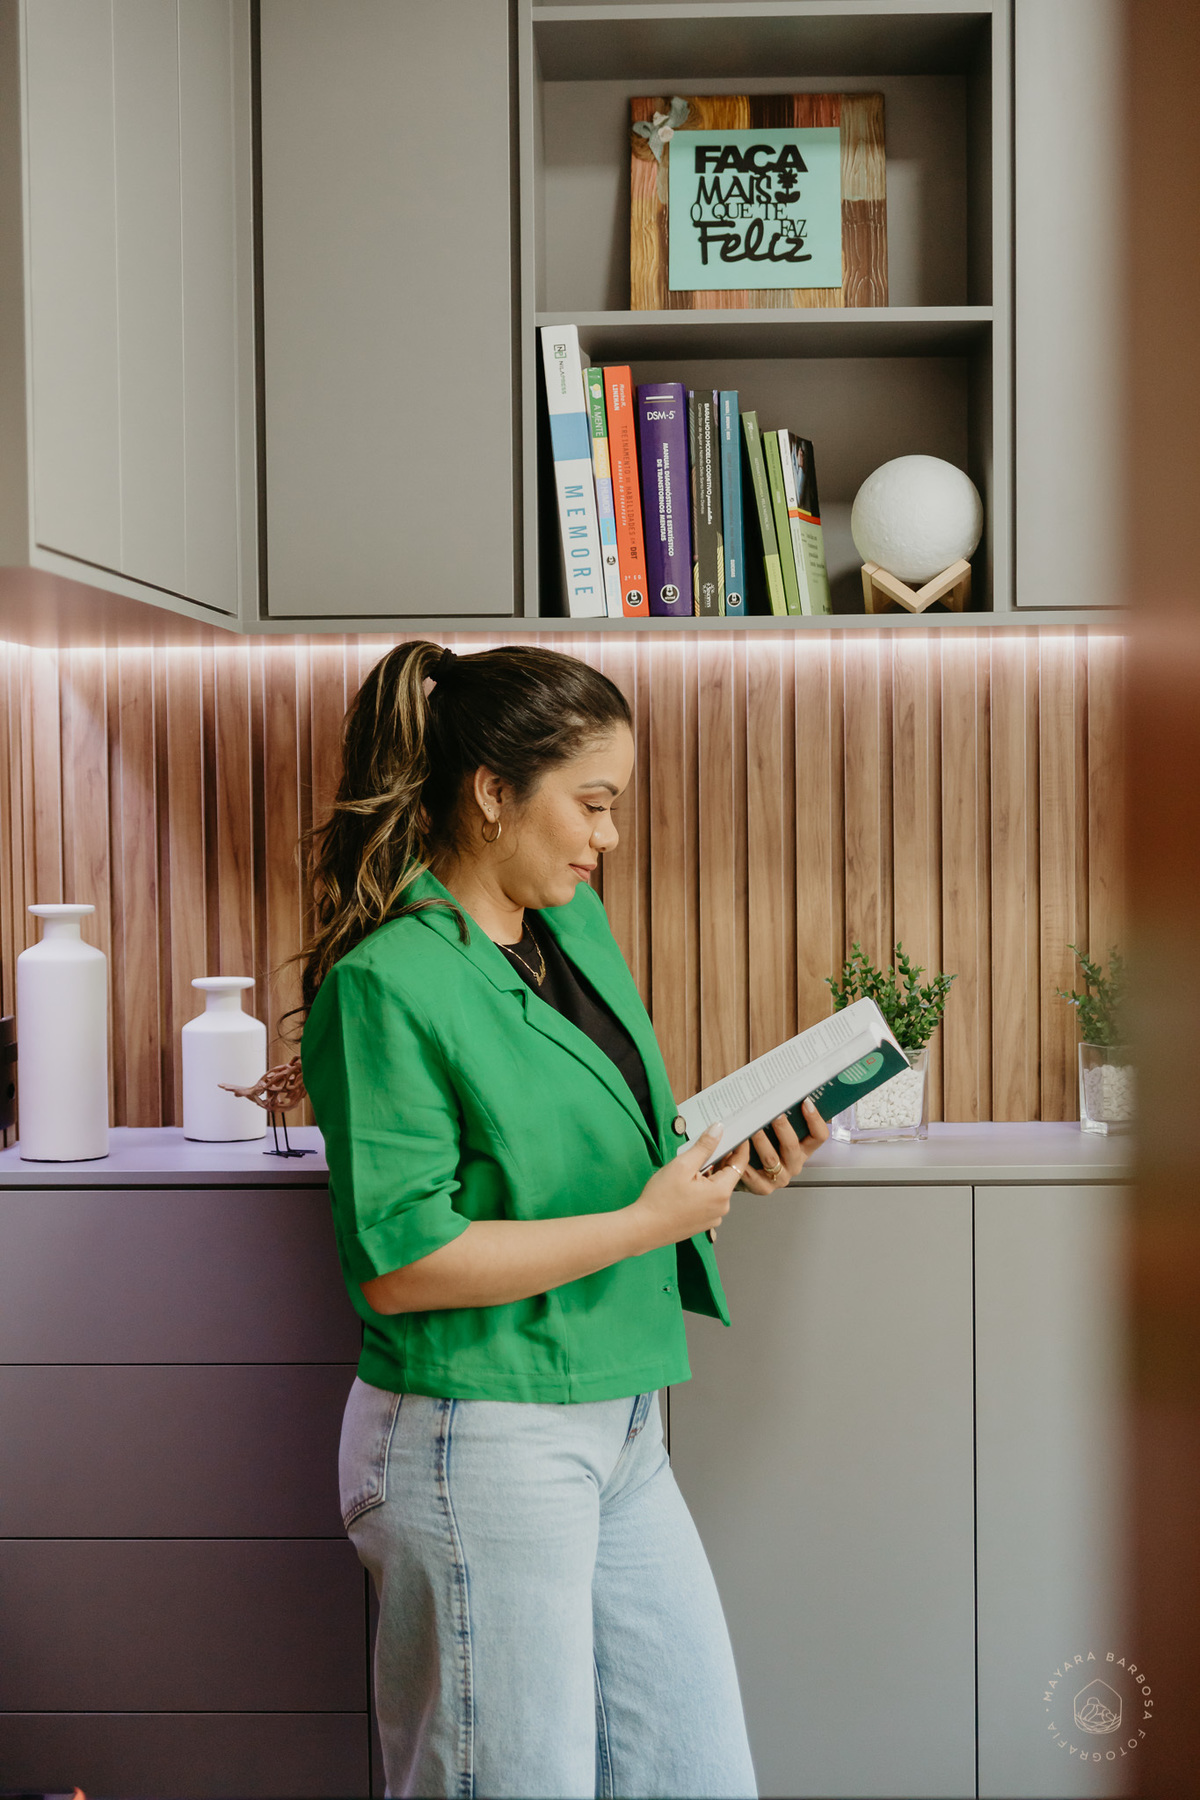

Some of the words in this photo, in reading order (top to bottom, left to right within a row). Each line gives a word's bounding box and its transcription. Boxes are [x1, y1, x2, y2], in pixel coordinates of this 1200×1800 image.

[694, 144, 808, 176] FAÇA
[696, 175, 772, 204] MAIS
[690, 203, 703, 221] O
[712, 203, 753, 221] QUE
[759, 202, 788, 220] TE
[693, 218, 812, 265] Feliz
[780, 219, 808, 237] FAZ
[594, 411, 604, 437] MENTE
[704, 431, 711, 440] DO
[621, 425, 631, 476] TREINAMENTO
[656, 458, 663, 467] DE
[662, 442, 670, 469] MANUAL
[664, 470, 673, 514] DIAGNÓSTICO
[626, 486, 636, 536] HABILIDADES
[564, 485, 594, 596] MEMORE
[659, 514, 667, 542] MENTAIS
[630, 547, 638, 560] DBT
